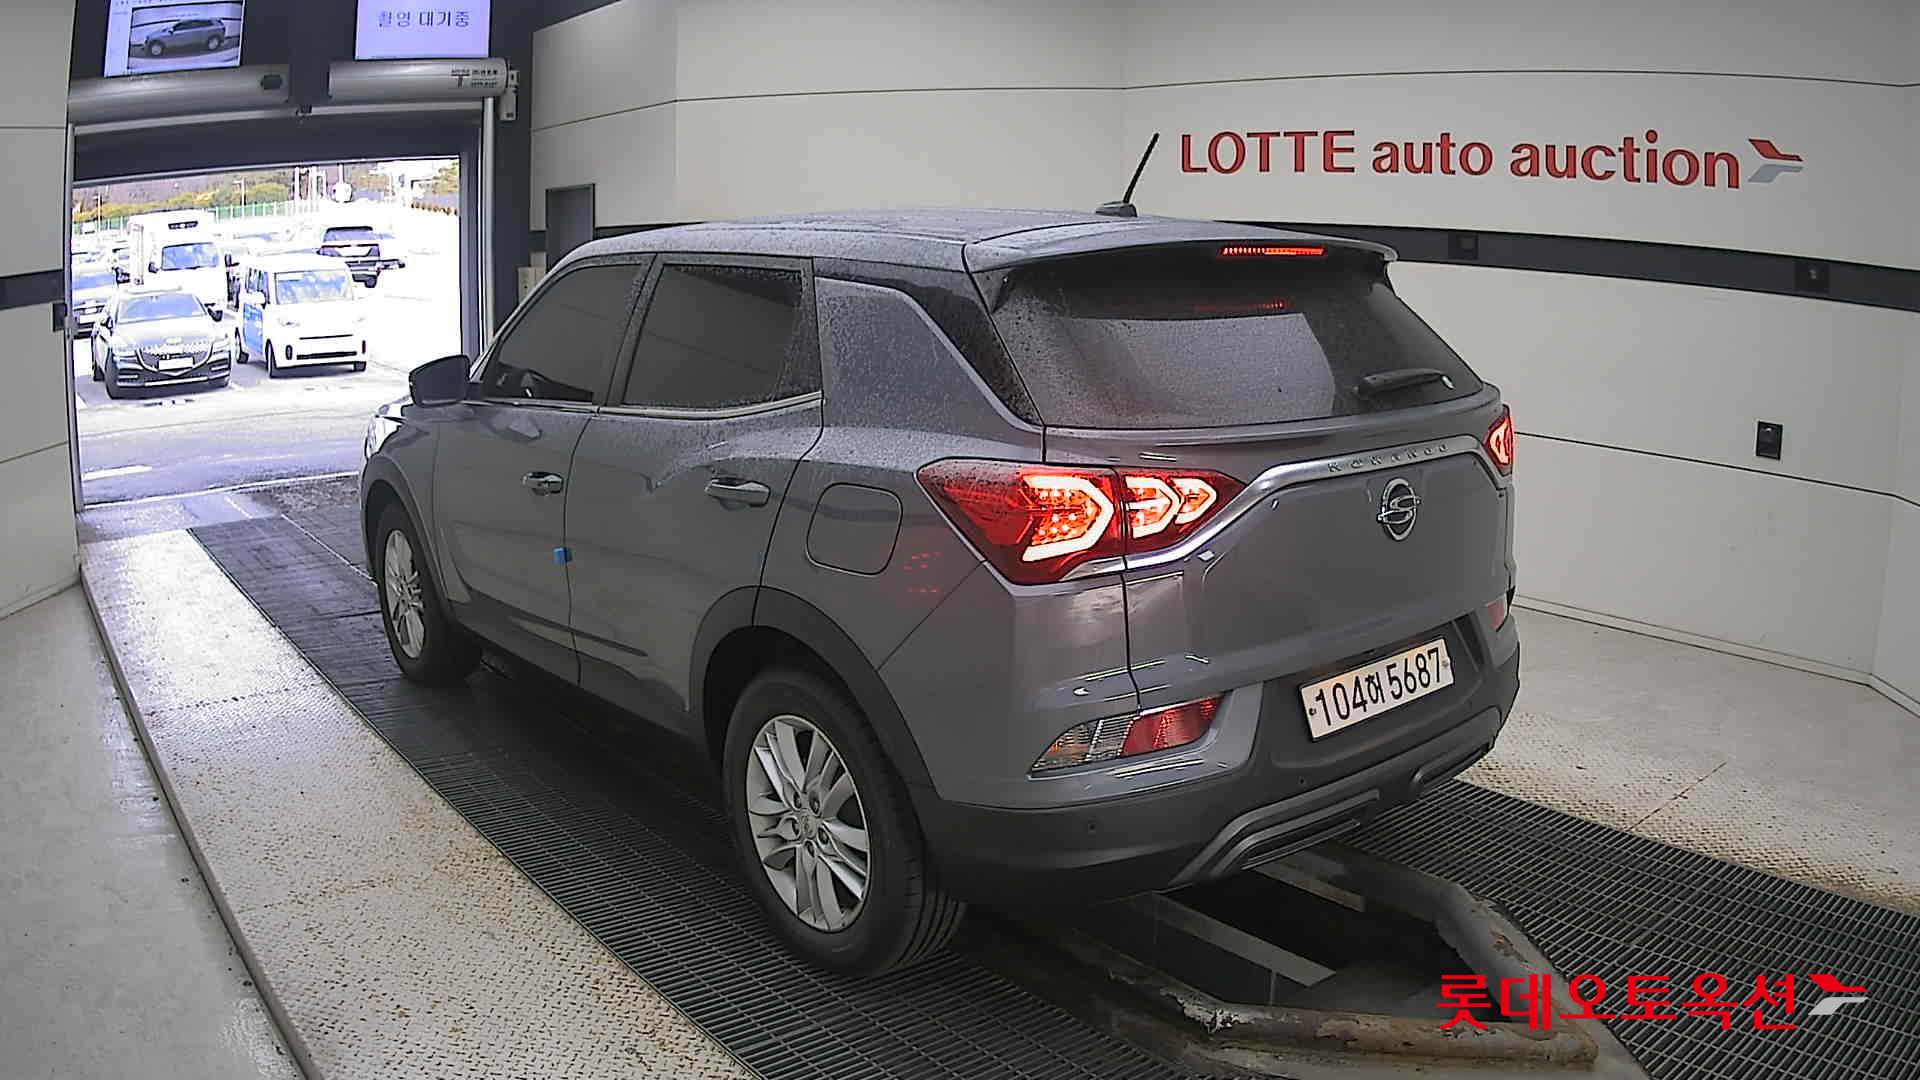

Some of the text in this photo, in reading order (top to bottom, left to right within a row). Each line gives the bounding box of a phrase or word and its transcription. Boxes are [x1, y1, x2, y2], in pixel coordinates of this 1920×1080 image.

[419, 11, 470, 27] 대기중
[1181, 129, 1740, 189] LOTTE auto auction
